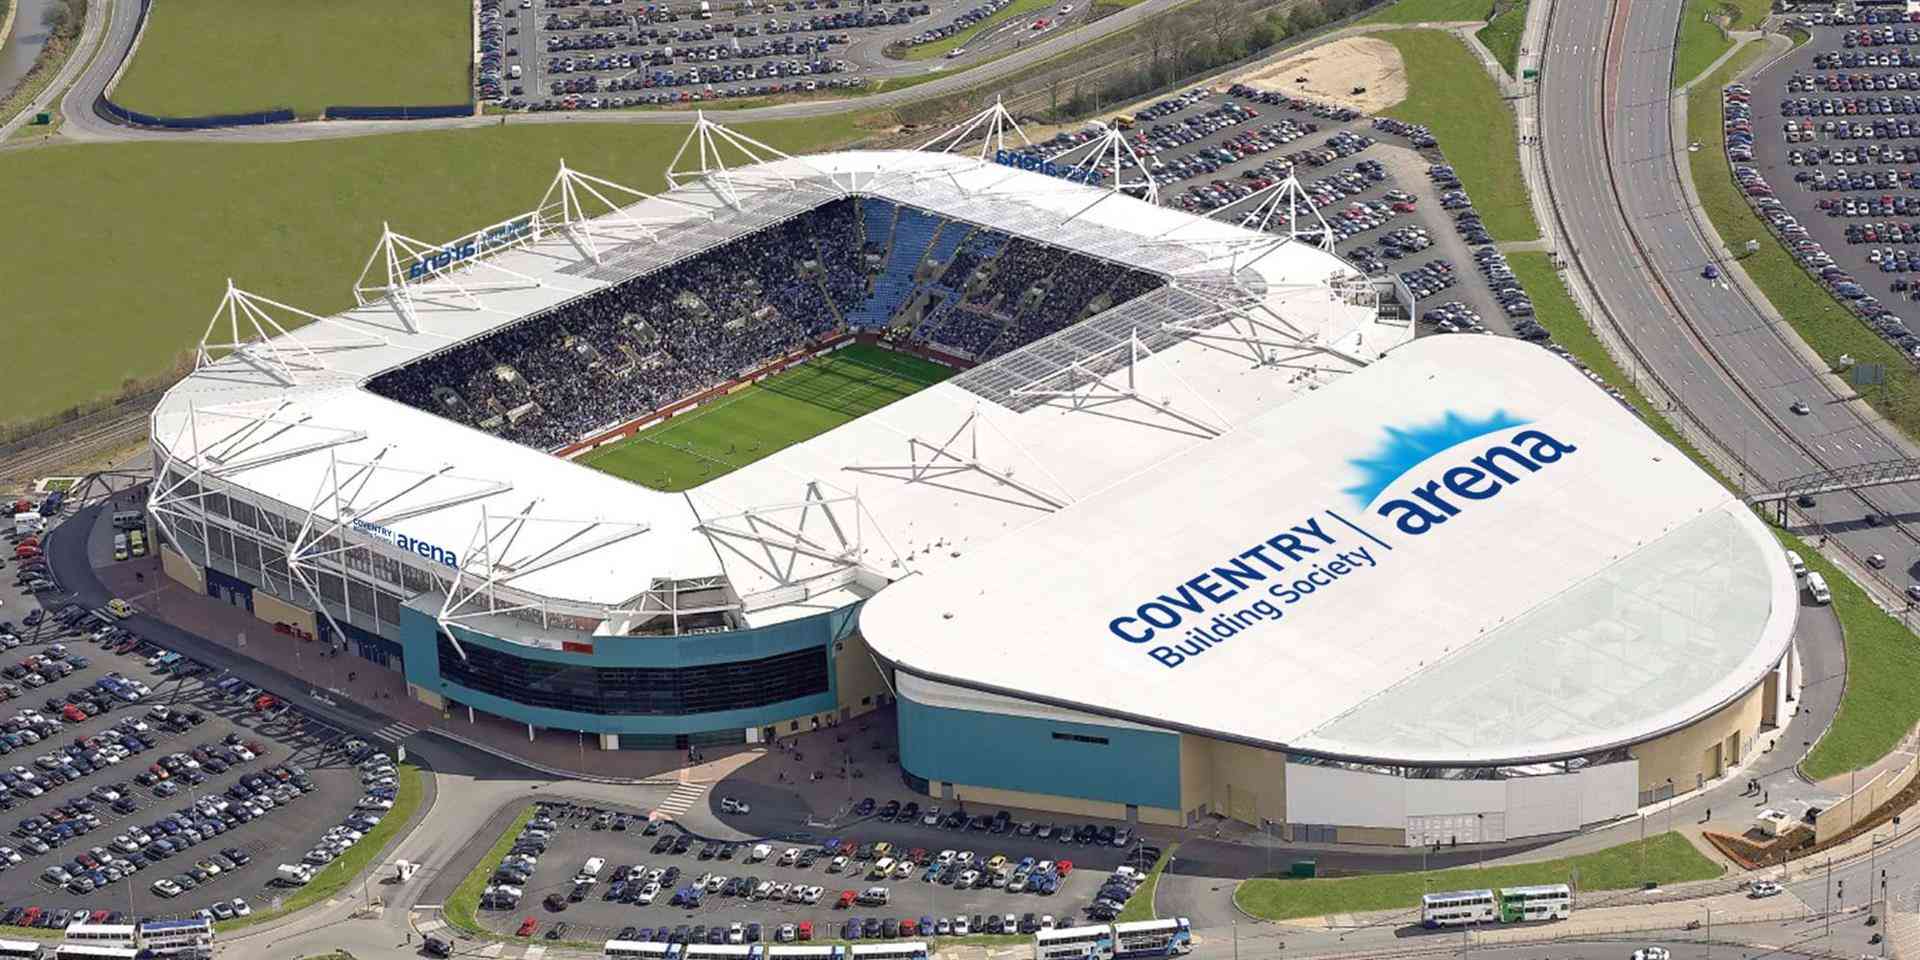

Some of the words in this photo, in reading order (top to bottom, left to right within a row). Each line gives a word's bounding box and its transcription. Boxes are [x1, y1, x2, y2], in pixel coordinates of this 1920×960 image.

[1377, 429, 1578, 536] arena
[397, 533, 460, 570] arena
[1109, 517, 1336, 644] COVENTRY
[1147, 597, 1283, 669] Building
[1270, 543, 1377, 604] Society
